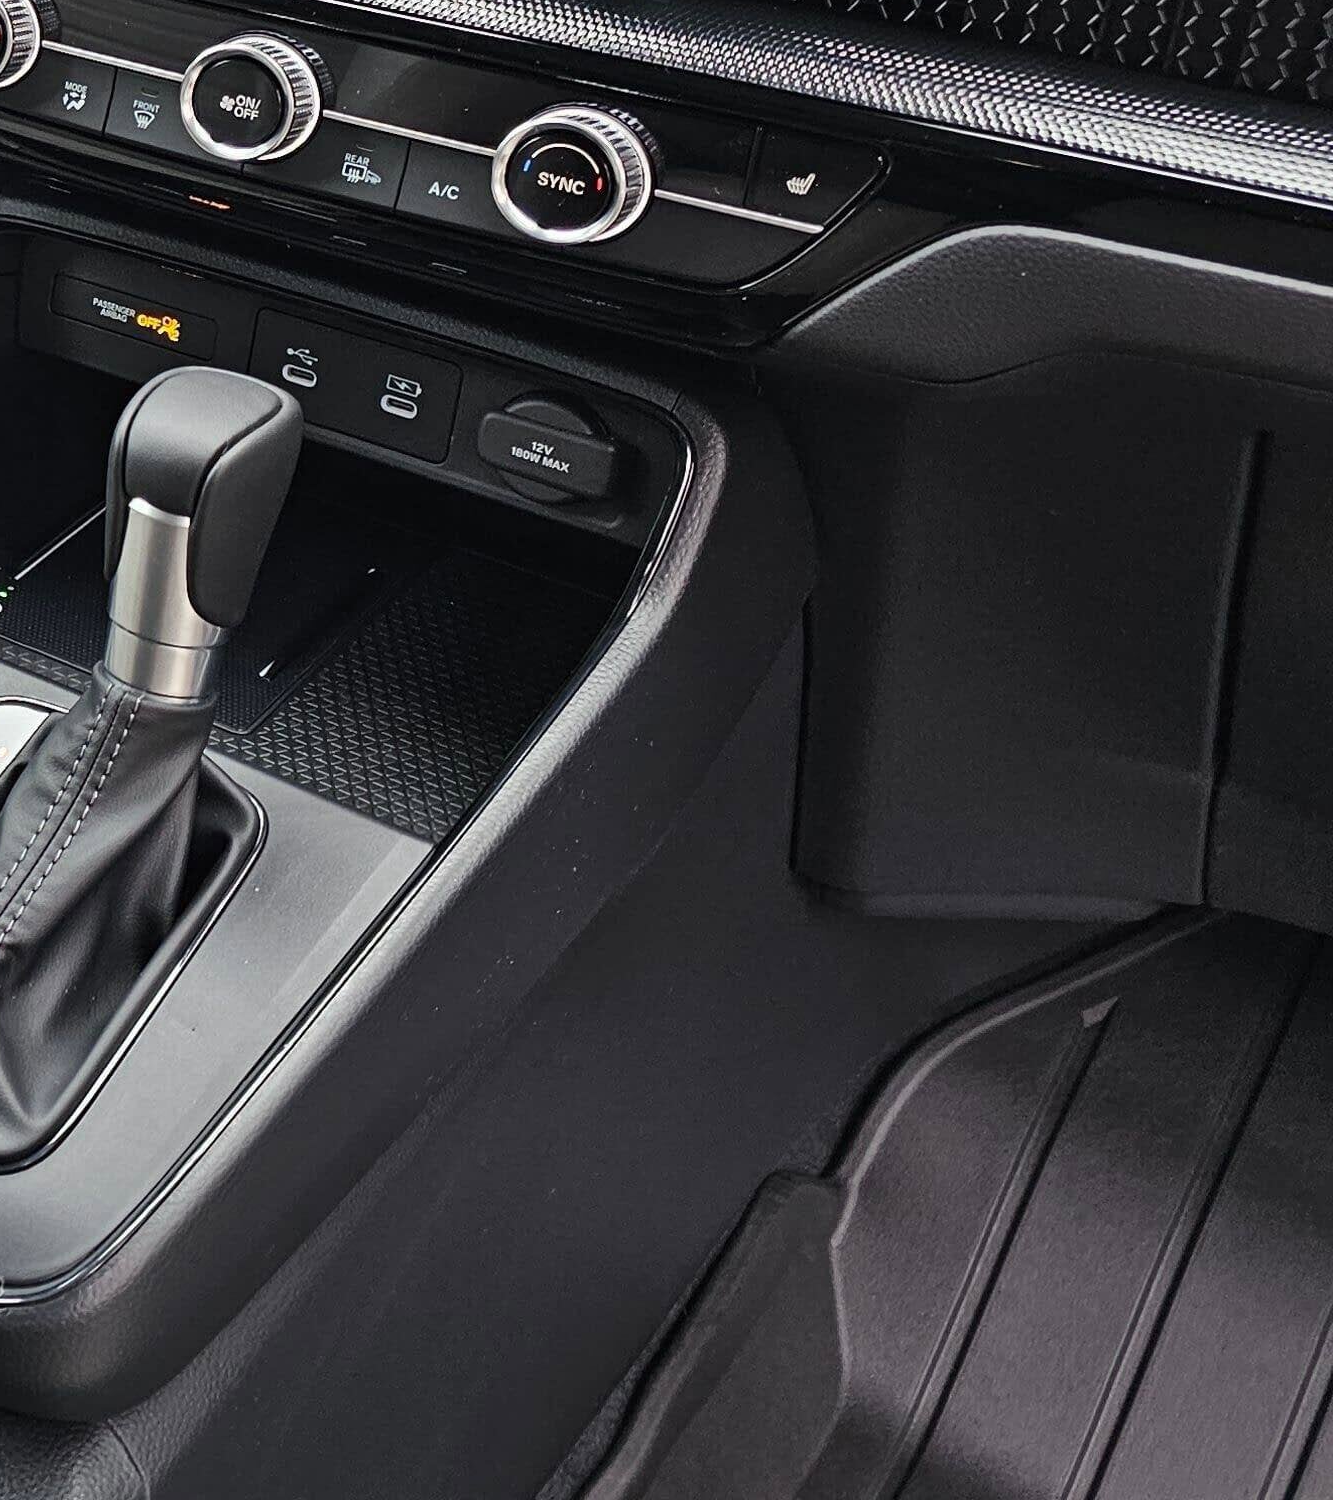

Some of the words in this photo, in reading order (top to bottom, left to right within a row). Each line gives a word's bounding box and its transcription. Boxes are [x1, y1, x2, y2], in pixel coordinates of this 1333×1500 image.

[64, 81, 88, 93] MODE
[133, 99, 161, 114] FRONT
[235, 94, 261, 110] ON/
[234, 106, 260, 121] OFF
[344, 152, 371, 166] REAR
[427, 181, 460, 200] A/C
[536, 171, 586, 195] SYNC
[93, 297, 136, 318] PASSENGER
[136, 314, 162, 329] OFF
[532, 441, 554, 456] 12V
[511, 446, 541, 463] 180W
[542, 456, 570, 473] MAX
